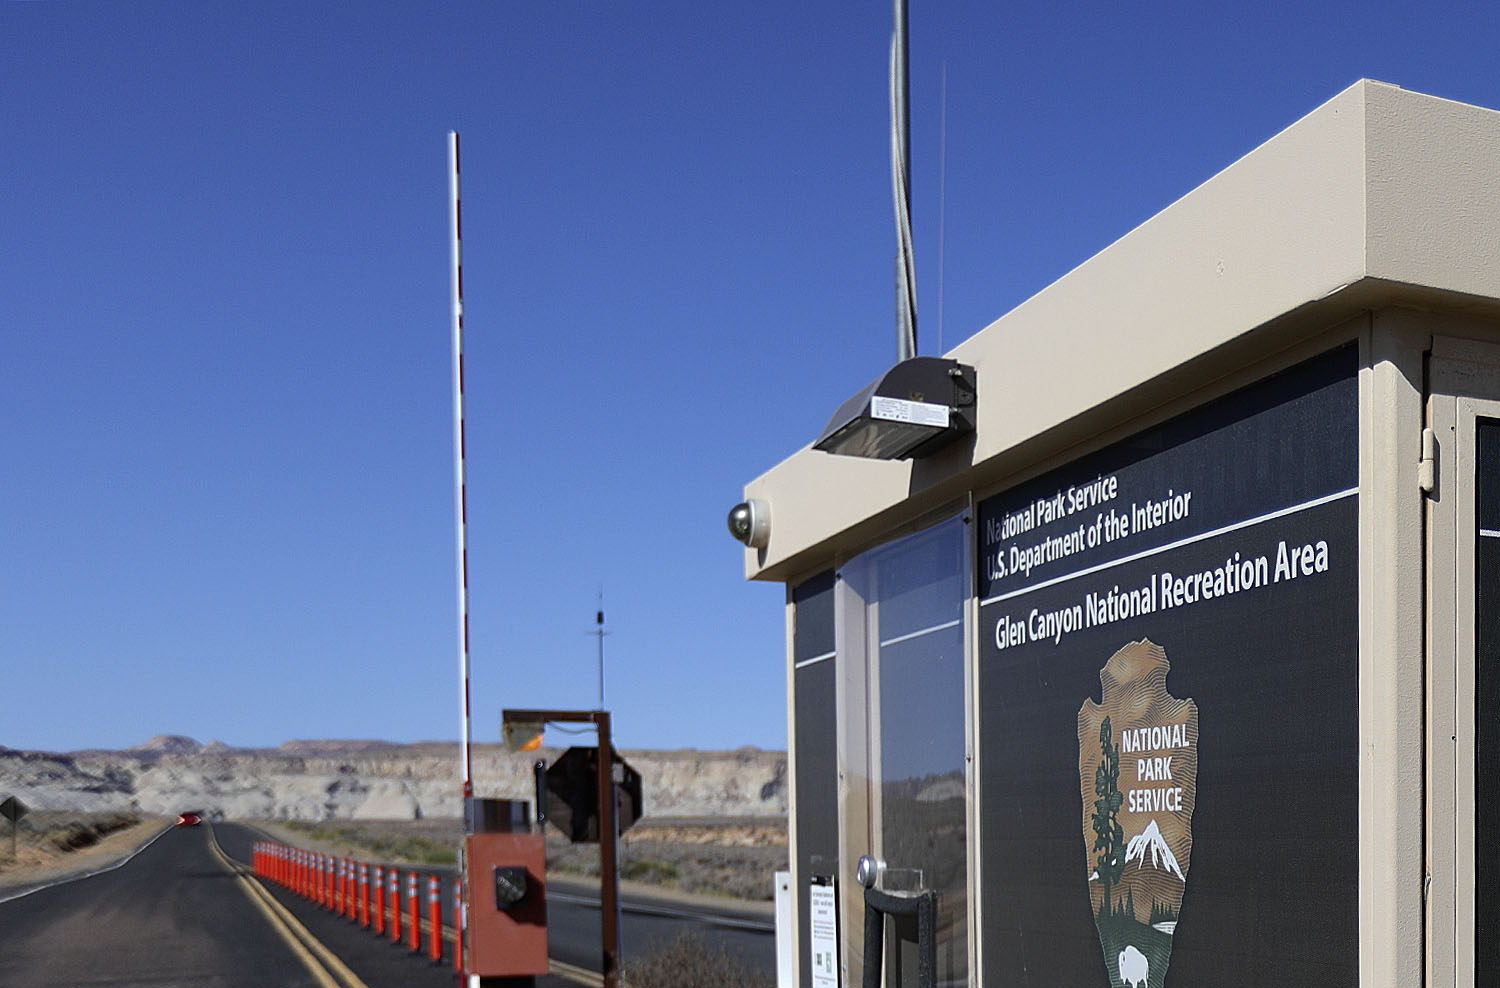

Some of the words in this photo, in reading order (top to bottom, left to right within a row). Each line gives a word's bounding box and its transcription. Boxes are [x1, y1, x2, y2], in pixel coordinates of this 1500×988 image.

[1037, 489, 1065, 527] Park
[1068, 473, 1118, 515] Service
[1010, 524, 1086, 577] Department
[1087, 513, 1103, 548] of
[1105, 507, 1129, 542] the
[1132, 489, 1192, 533] Interior
[995, 616, 1026, 650] Glen
[1029, 602, 1083, 646] Canyon
[1086, 573, 1157, 629] National
[1161, 551, 1269, 611] Recreation
[1274, 539, 1329, 584] Area
[1122, 723, 1190, 753] NATIONAL
[1137, 756, 1173, 782] PARK
[1128, 787, 1183, 813] SERVICE
